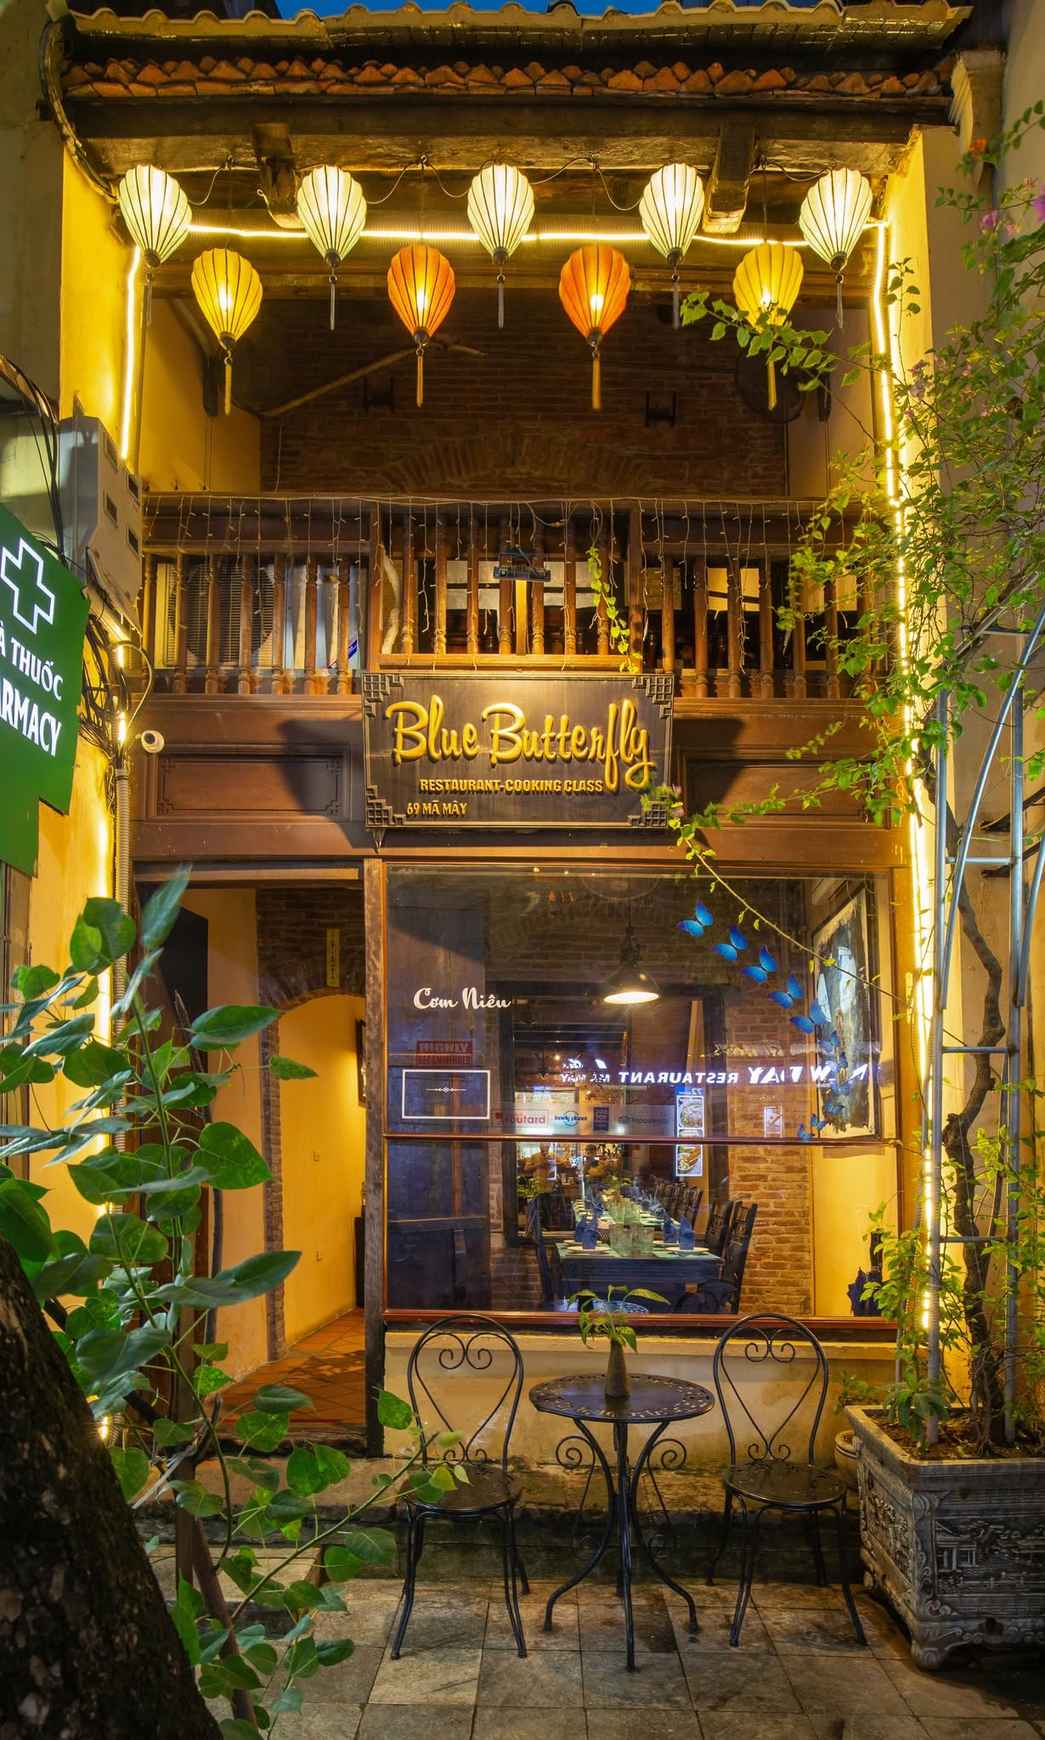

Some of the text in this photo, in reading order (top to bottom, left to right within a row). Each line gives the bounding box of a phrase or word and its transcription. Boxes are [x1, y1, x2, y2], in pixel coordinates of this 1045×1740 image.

[11, 636, 63, 701] THUỐC
[0, 677, 62, 757] RMACY
[385, 694, 656, 792] Blue Butterfly
[407, 802, 420, 815] 69
[413, 986, 512, 1010] Cơm Niêu
